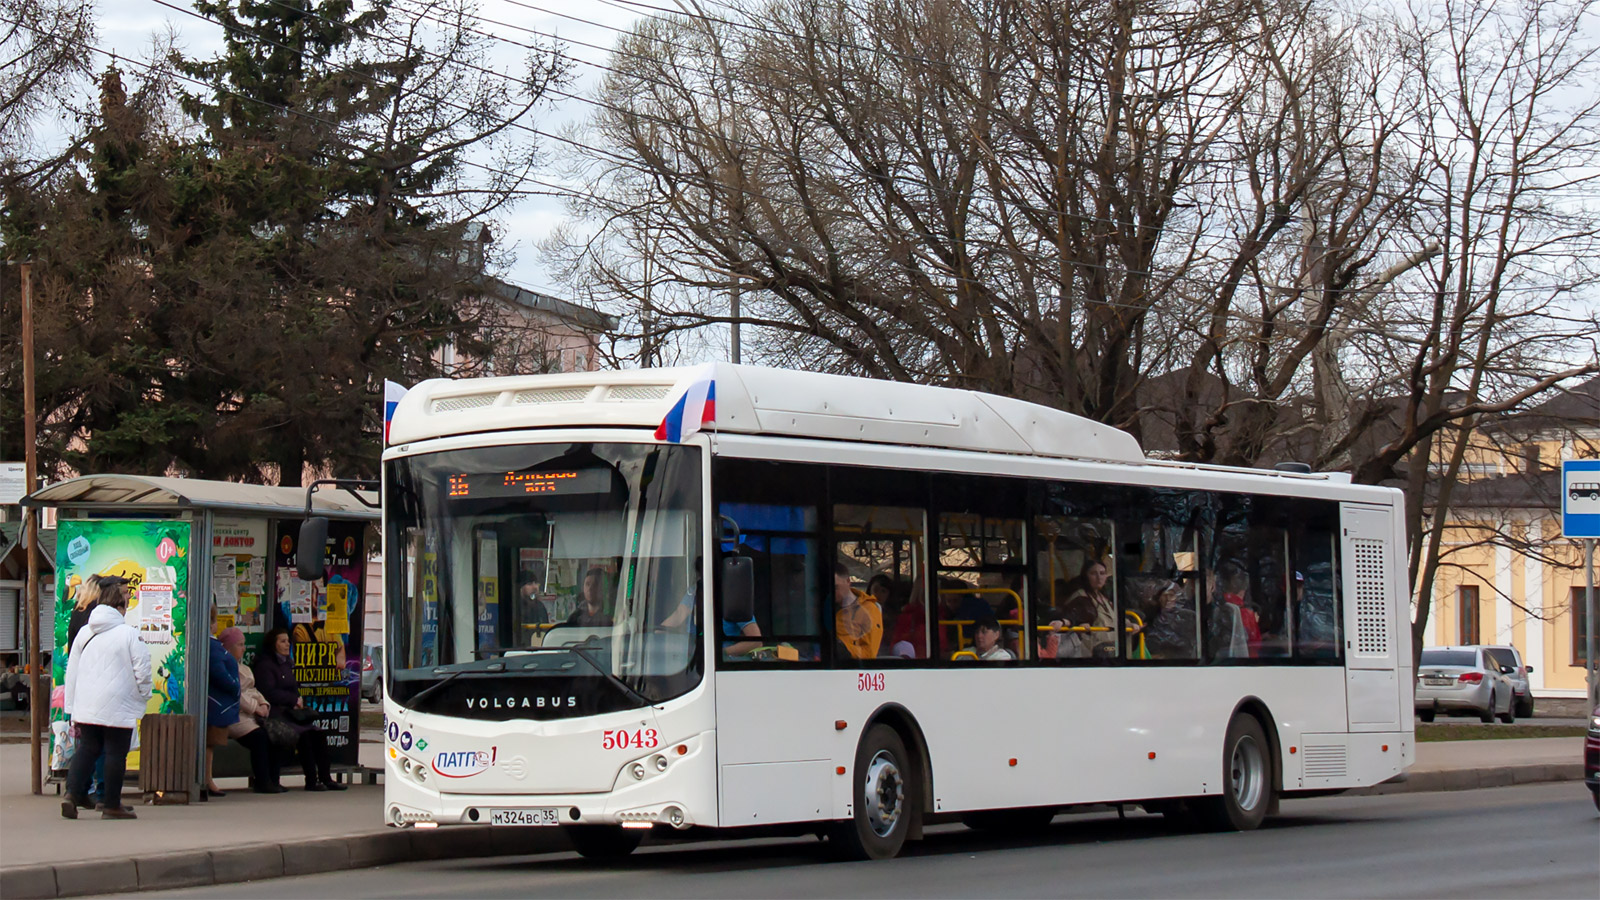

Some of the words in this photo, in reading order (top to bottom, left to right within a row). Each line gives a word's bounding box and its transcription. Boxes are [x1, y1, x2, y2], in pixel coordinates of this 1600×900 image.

[449, 473, 468, 496] 16
[160, 541, 173, 559] 0+
[223, 536, 255, 547] ДОКТОР
[331, 553, 337, 566] 7
[295, 643, 338, 668] ЦИРК
[857, 672, 886, 692] 5043
[466, 696, 577, 709] VOLGABUS
[321, 719, 329, 730] 22
[330, 719, 338, 730] 10
[602, 728, 659, 750] 5043
[437, 751, 476, 768] ПАТП
[542, 810, 555, 821] 35
